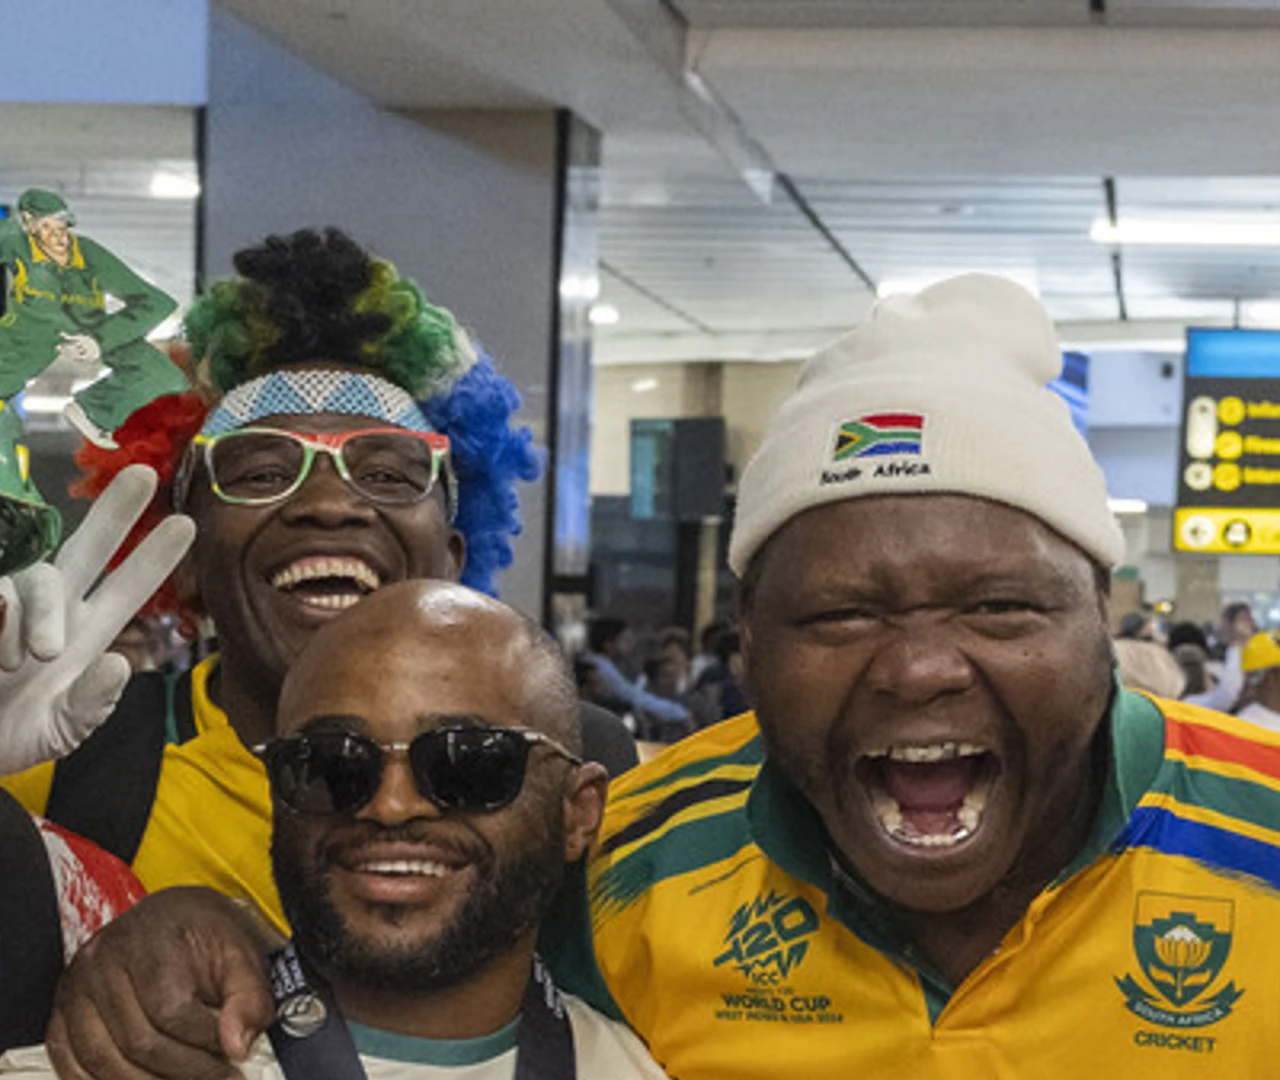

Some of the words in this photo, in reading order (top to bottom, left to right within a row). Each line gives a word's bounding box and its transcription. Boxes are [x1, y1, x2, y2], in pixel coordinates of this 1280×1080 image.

[873, 462, 931, 478] Africa
[723, 993, 786, 1012] WORLD
[790, 996, 831, 1012] CUP
[1133, 1030, 1216, 1052] CRICKET
